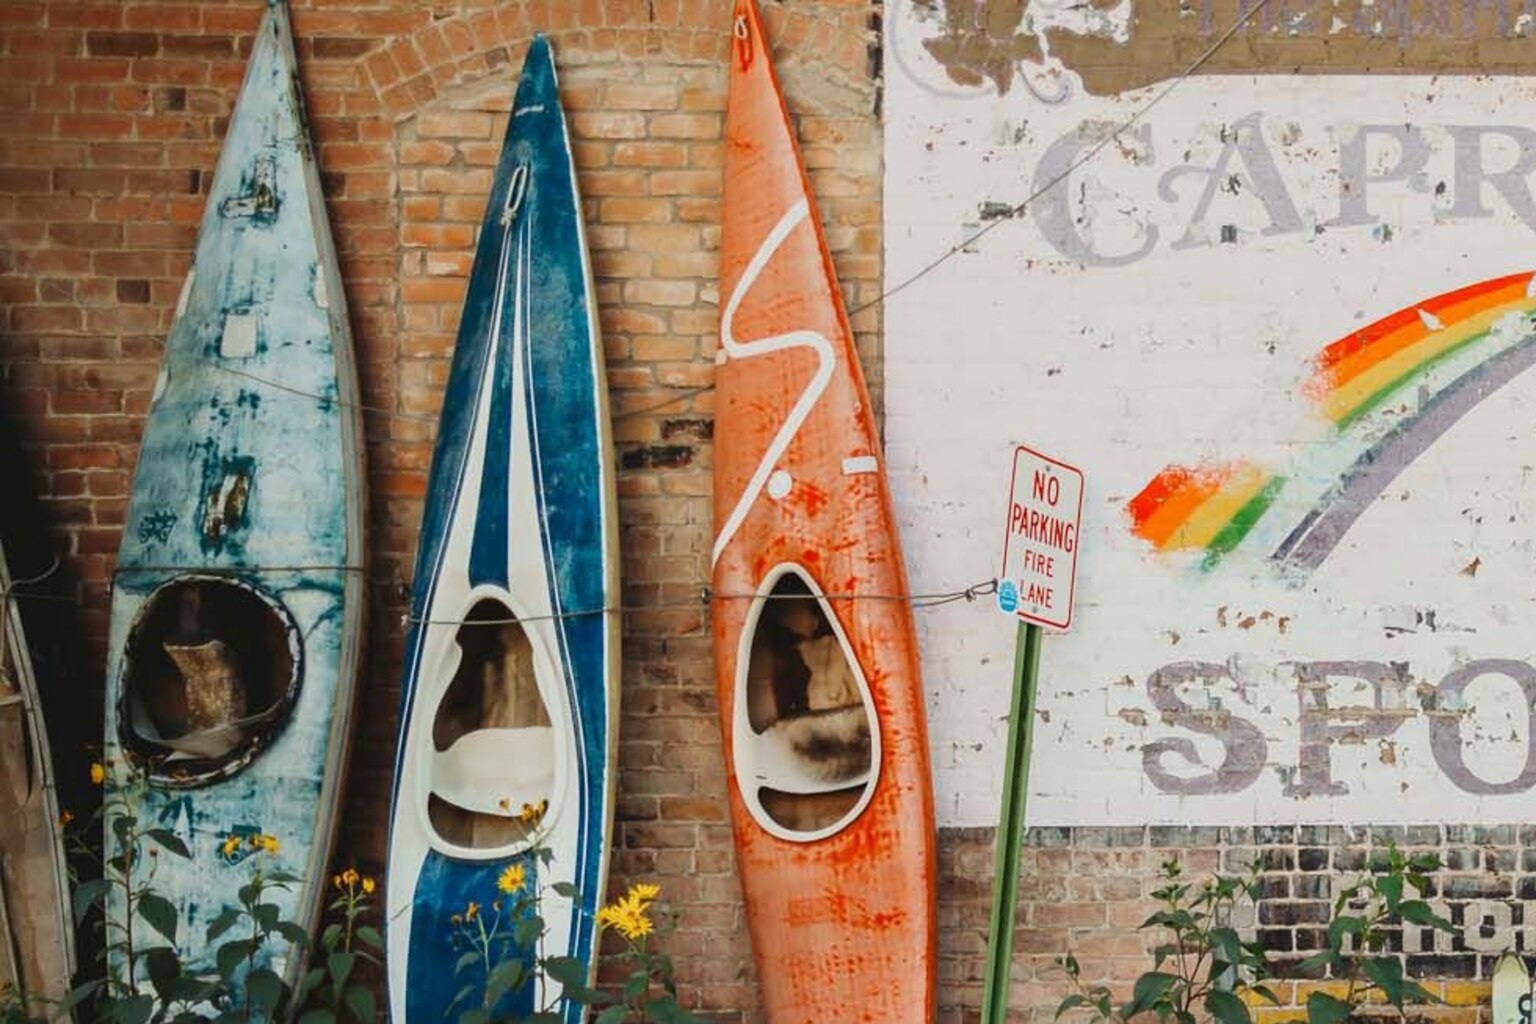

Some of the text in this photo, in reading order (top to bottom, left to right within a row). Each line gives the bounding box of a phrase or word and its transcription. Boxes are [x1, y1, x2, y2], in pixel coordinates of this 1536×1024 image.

[1032, 470, 1060, 506] NO
[1012, 503, 1075, 553] PARKING
[1023, 550, 1054, 578] FIRE
[1020, 579, 1053, 609] LANE
